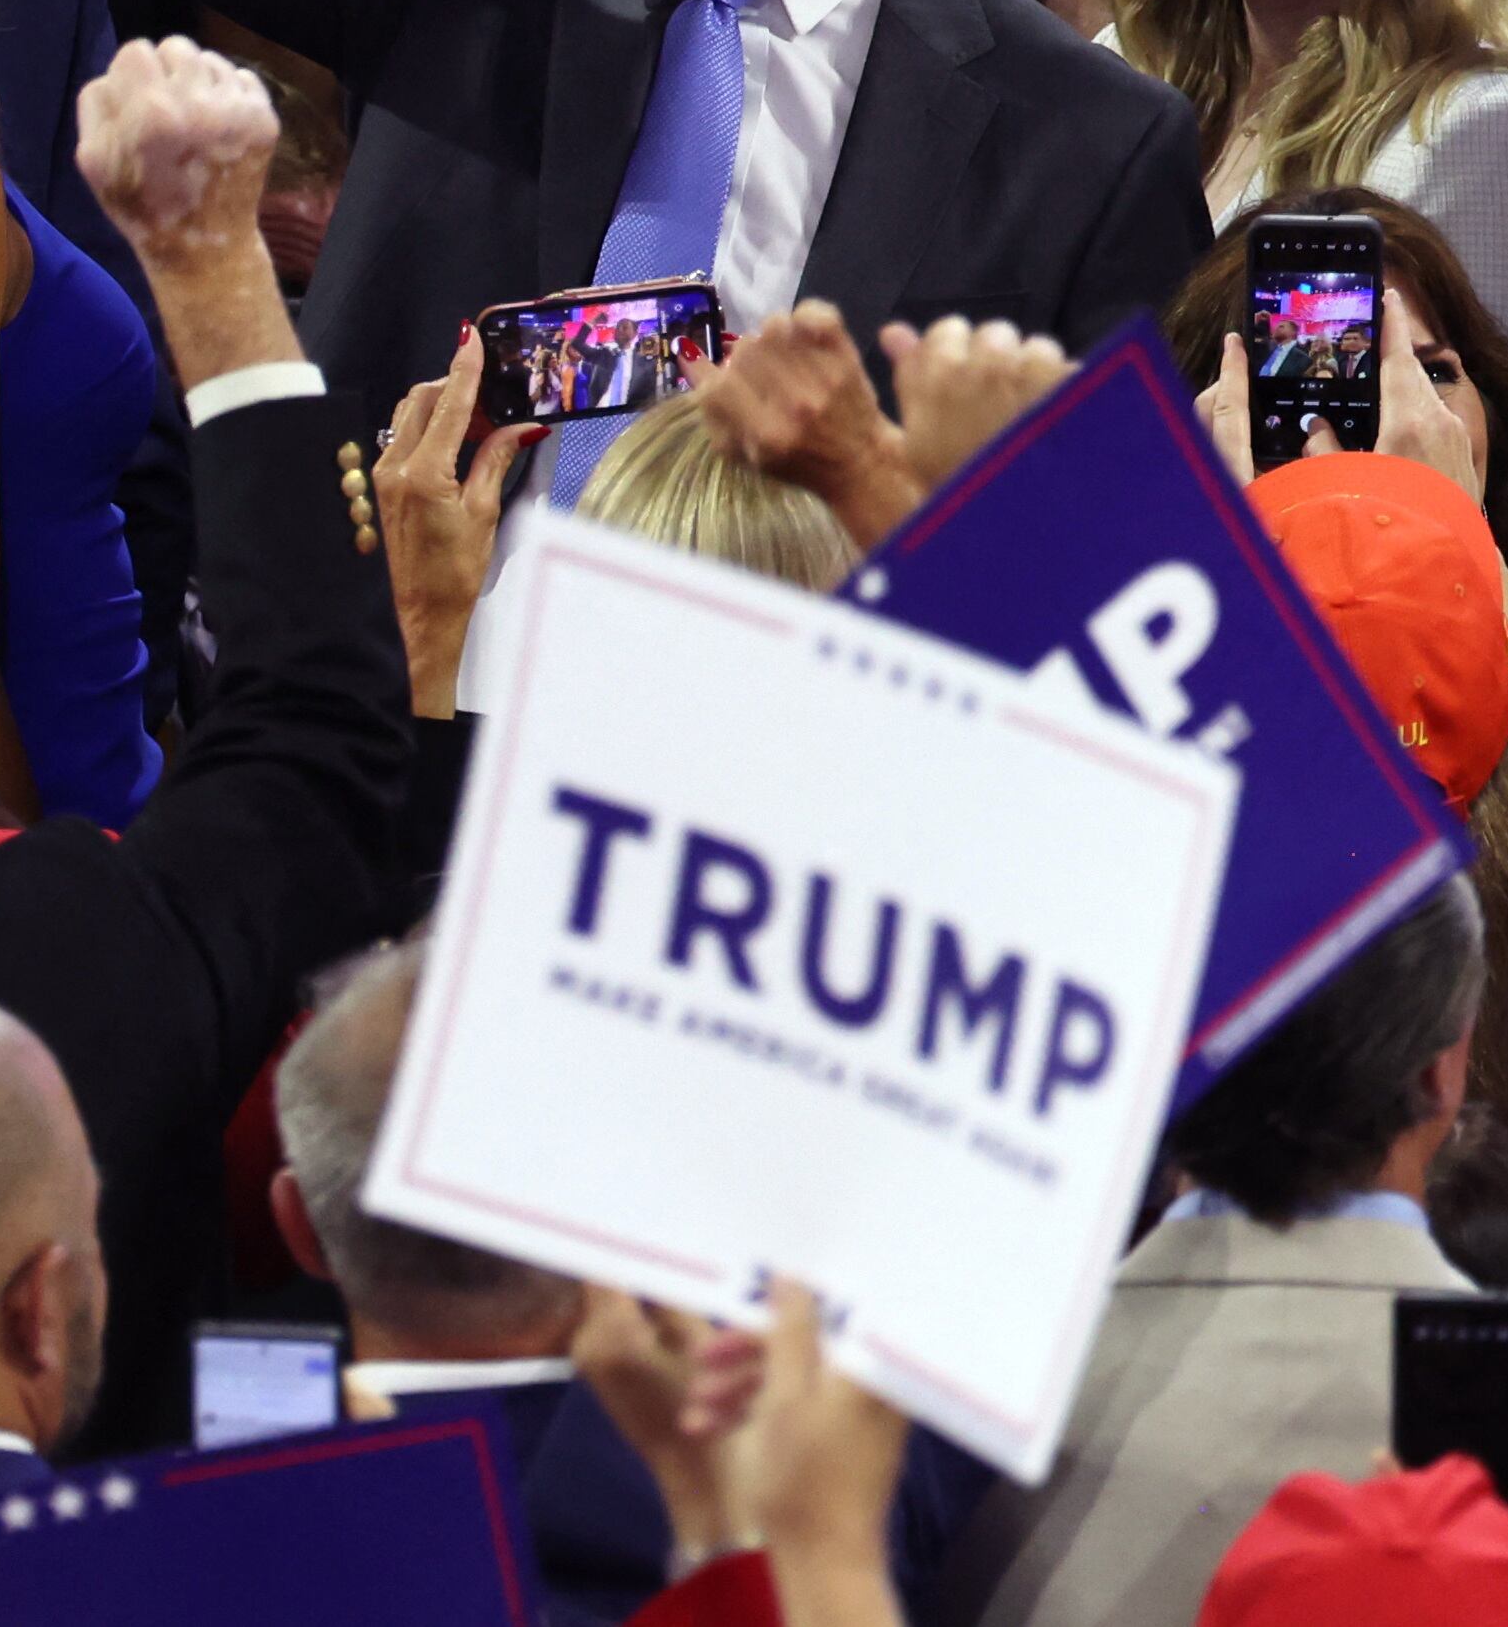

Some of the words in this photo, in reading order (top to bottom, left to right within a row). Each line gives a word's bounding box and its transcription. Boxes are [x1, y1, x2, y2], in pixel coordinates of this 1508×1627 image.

[549, 966, 662, 1024] MAKE
[679, 1009, 848, 1084] AMERICA
[551, 784, 1116, 1116] TRUMP
